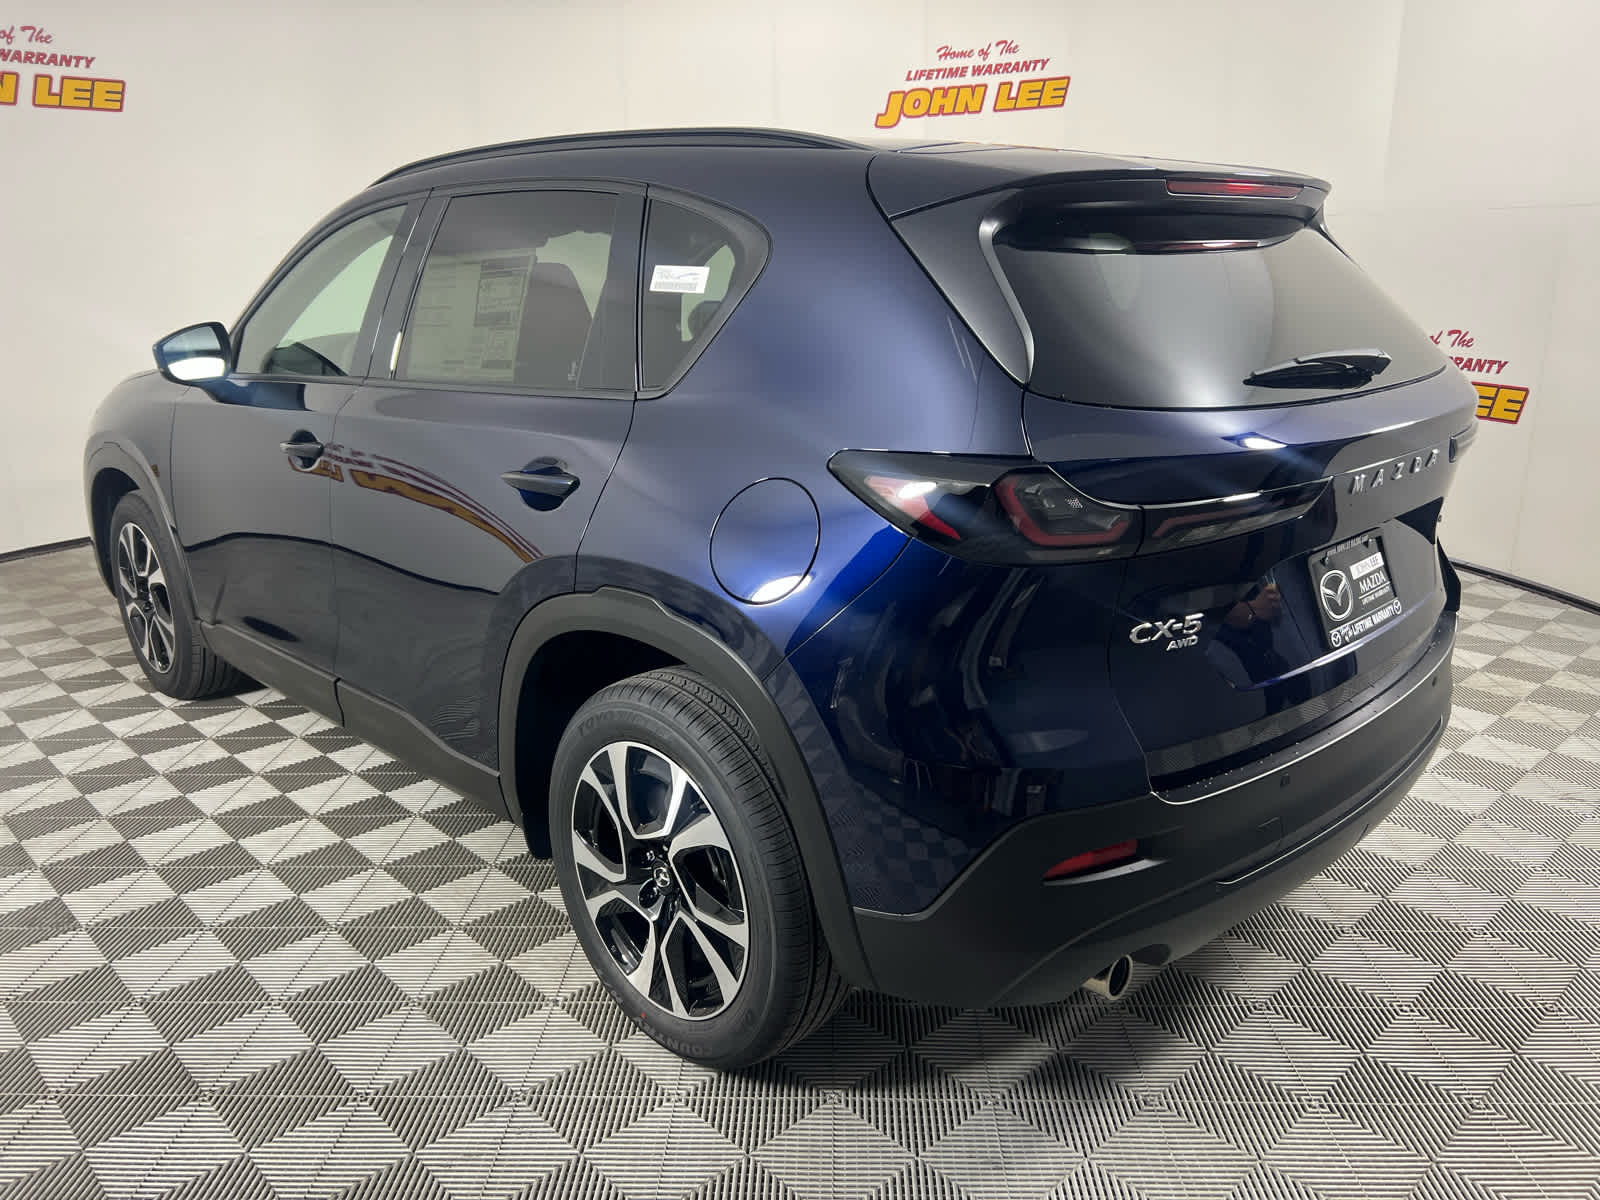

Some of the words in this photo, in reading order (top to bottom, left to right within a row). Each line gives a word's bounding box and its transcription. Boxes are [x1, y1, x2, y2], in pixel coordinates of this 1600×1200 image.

[20, 25, 53, 44] The
[0, 48, 96, 69] WARRANTY
[936, 45, 975, 62] Home
[977, 43, 991, 61] of
[995, 39, 1020, 56] The
[905, 66, 969, 82] LIFETIME
[971, 58, 1050, 77] WARRANTY
[32, 73, 126, 112] LEE
[874, 83, 988, 129] JOHN
[993, 76, 1071, 112] LEE
[1447, 329, 1475, 348] The
[1449, 356, 1510, 375] RANTY
[1470, 381, 1530, 425] EE
[1350, 448, 1439, 494] MAZDA
[1358, 570, 1386, 593] MAZDA
[1129, 612, 1204, 644] CX-5
[1352, 616, 1372, 635] LIFETIME
[1371, 605, 1395, 625] WARRANTY
[1166, 635, 1199, 652] AWD
